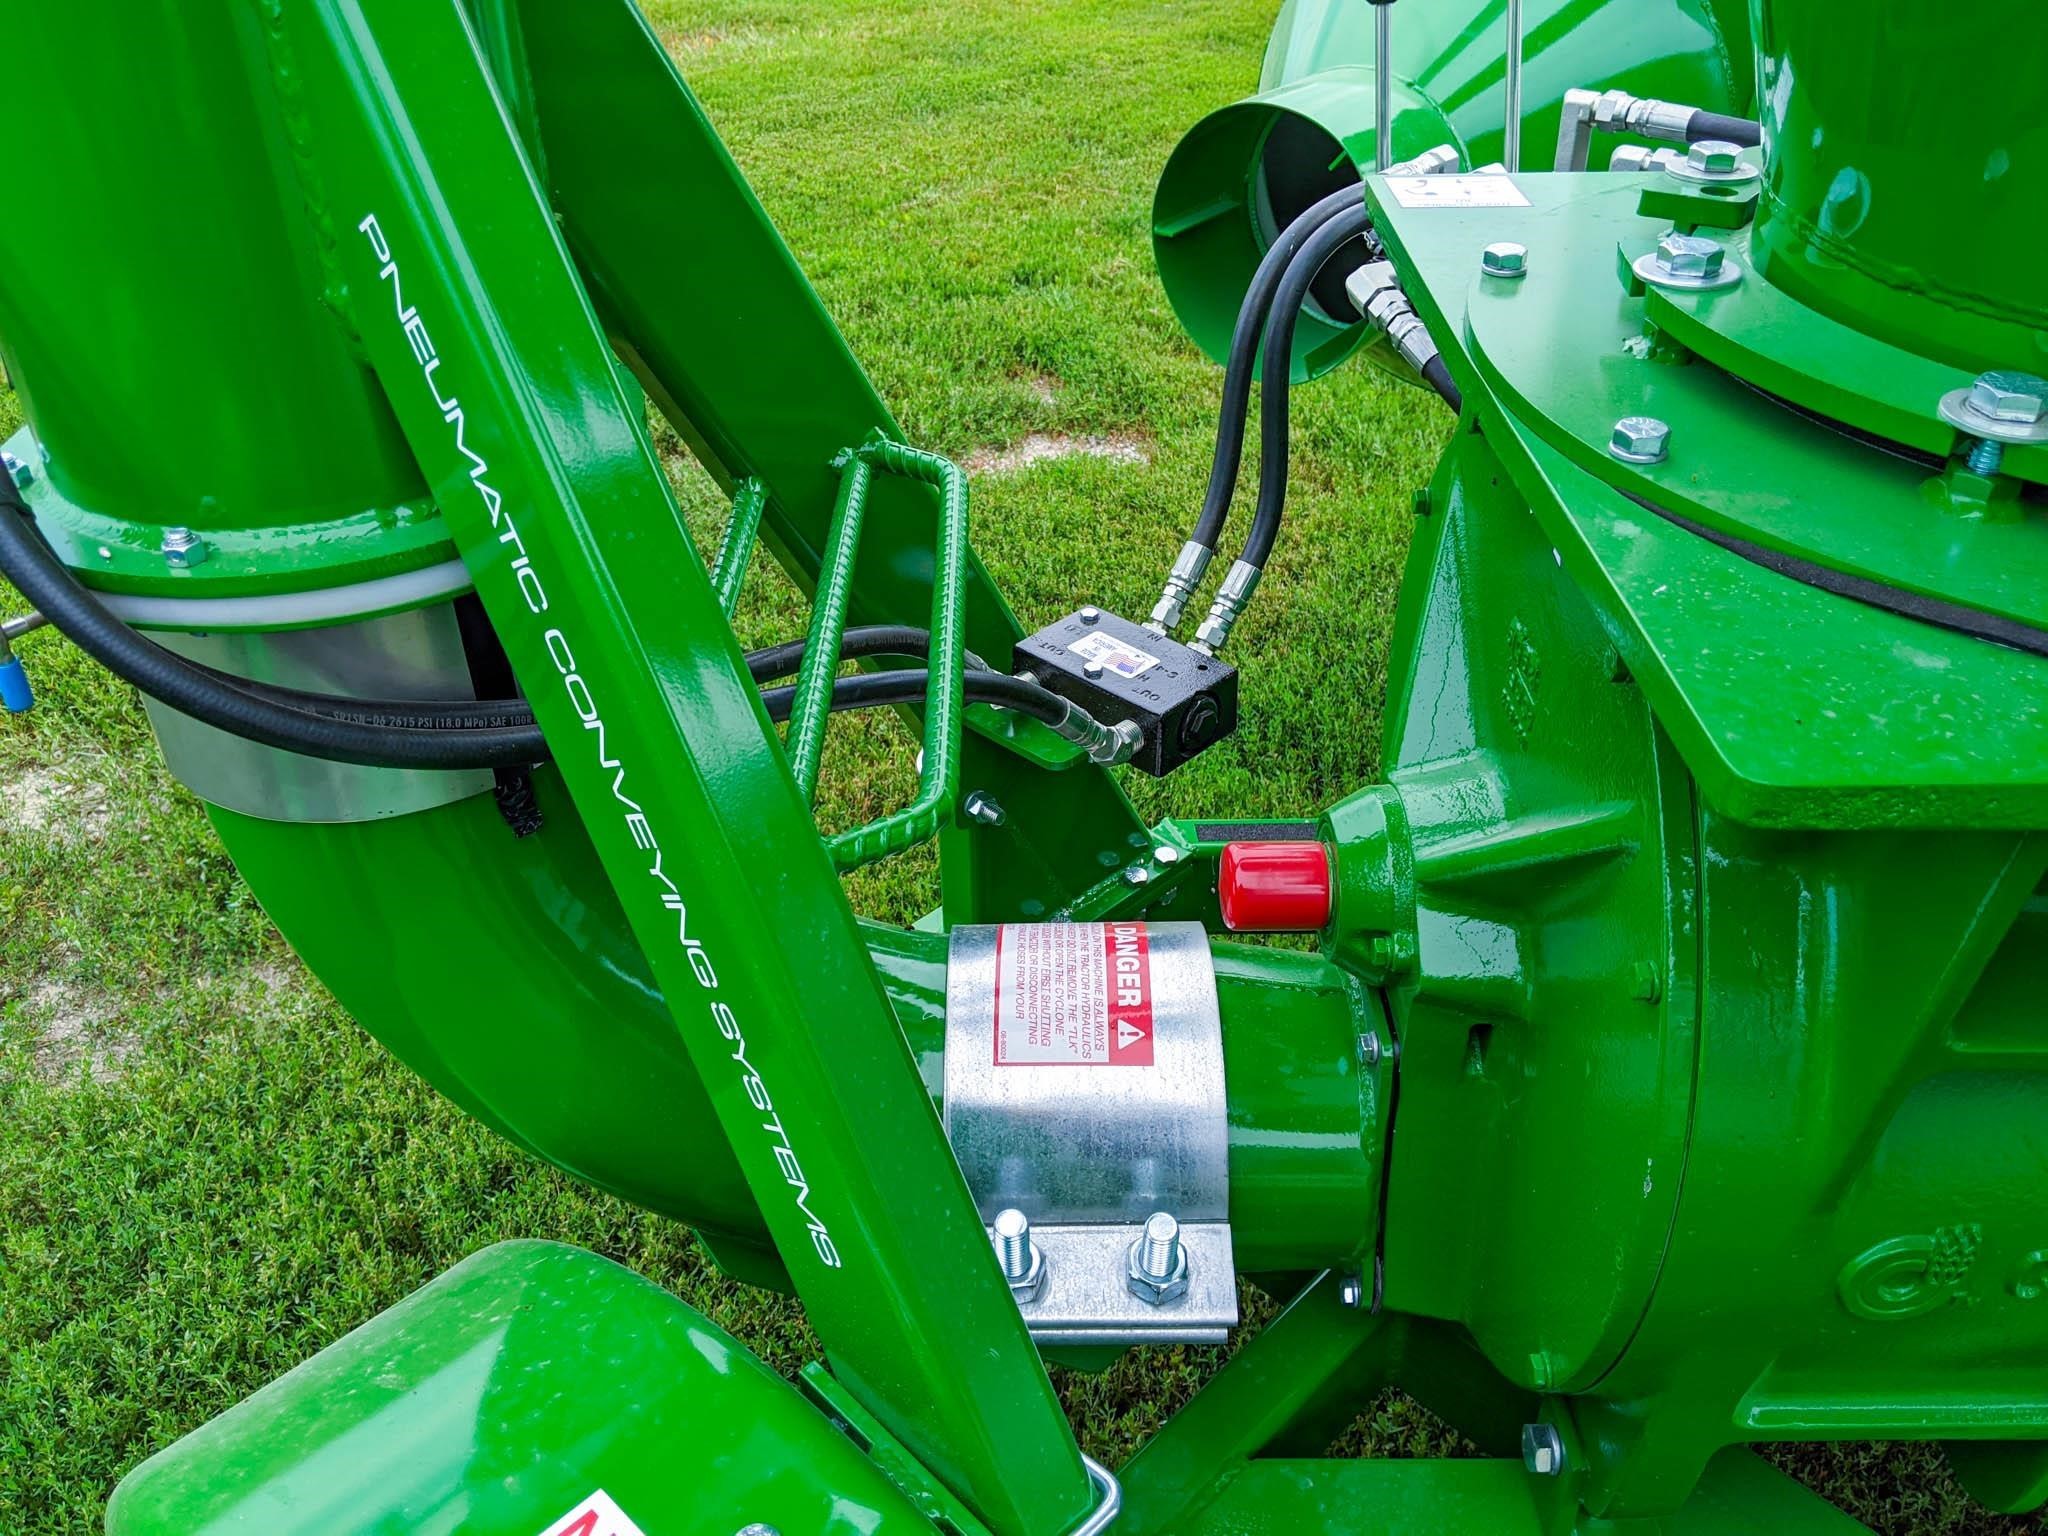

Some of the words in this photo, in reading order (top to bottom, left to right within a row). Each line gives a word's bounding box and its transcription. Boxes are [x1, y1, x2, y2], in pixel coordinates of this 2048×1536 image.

[389, 716, 415, 727] 2615
[418, 717, 433, 728] PSI
[490, 716, 506, 727] SAE
[358, 213, 549, 614] PNEUMATIC
[543, 628, 719, 989] CONVEYING
[709, 1001, 842, 1269] SYSTEMS
[1016, 943, 1026, 964] HOSES
[1029, 954, 1038, 965] OR
[1042, 939, 1051, 968] WITHOUT
[1055, 949, 1064, 968] OPEN
[1067, 949, 1076, 963] NOT
[1080, 941, 1089, 952] THE
[1093, 944, 1102, 958] THIS
[1016, 965, 1026, 990] FROM
[1055, 970, 1064, 985] THE
[1080, 954, 1090, 990] TRACTOR
[1093, 958, 1104, 996] MACHINE
[1114, 927, 1143, 1007] DANGER
[1041, 969, 1051, 993] FIRST
[1067, 964, 1077, 1000] REMOVE
[1015, 992, 1025, 1020] YOUR
[1028, 966, 1039, 1045] DISCONNECTING
[1055, 987, 1065, 1036] CYCLONE
[1068, 1003, 1077, 1023] THE
[1094, 998, 1104, 1008] IS
[1041, 994, 1051, 1047] SHUTTING
[1081, 992, 1092, 1059] HYDRAULICS
[1094, 1008, 1105, 1051] ALWAYS
